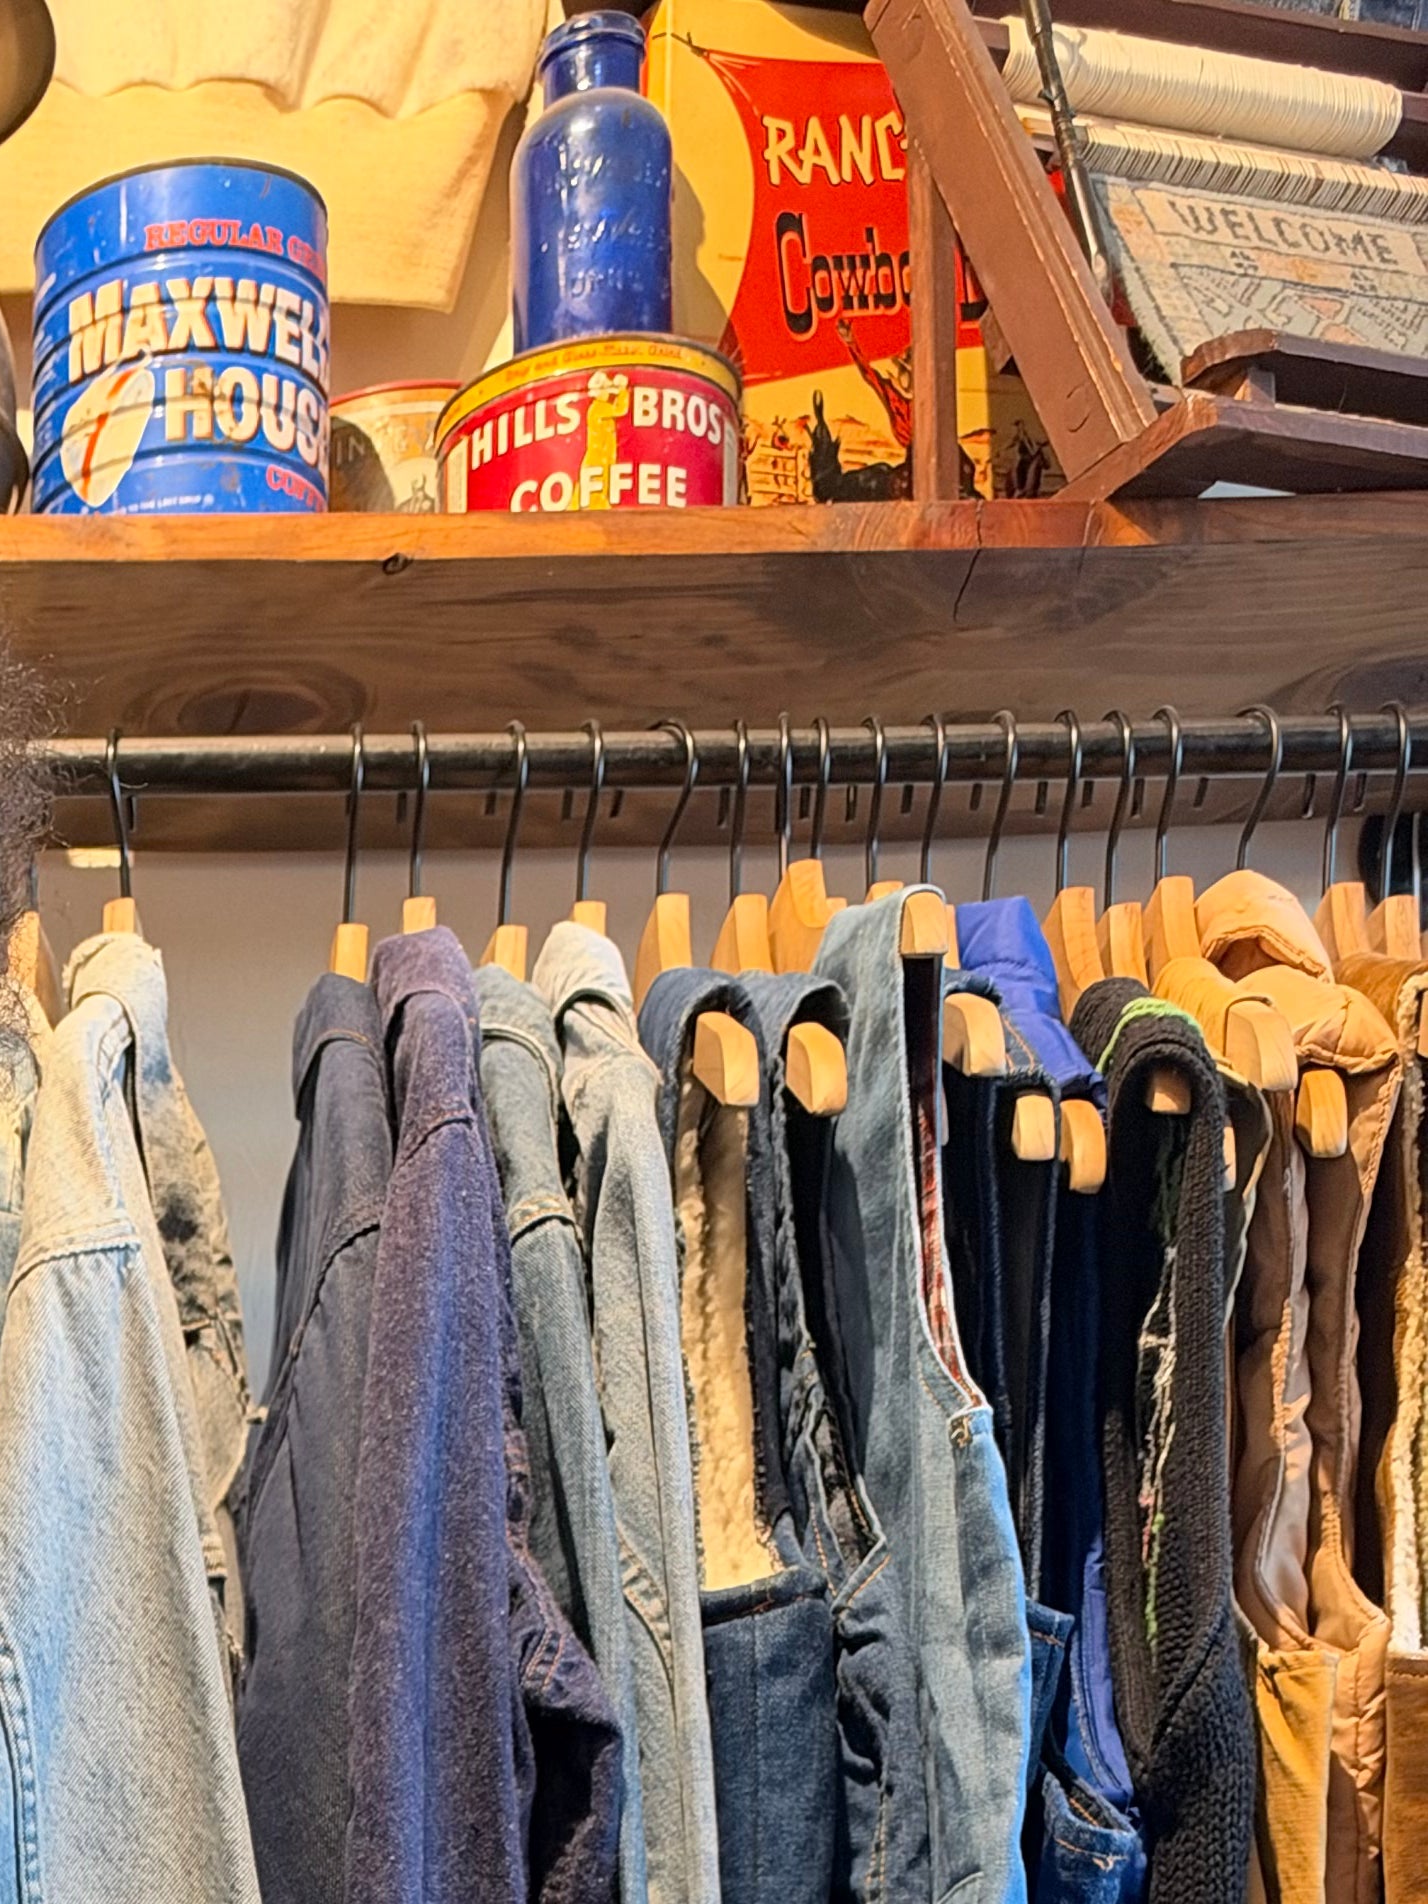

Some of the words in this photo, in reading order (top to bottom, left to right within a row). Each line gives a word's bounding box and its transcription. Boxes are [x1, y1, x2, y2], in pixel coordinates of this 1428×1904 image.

[762, 111, 908, 186] RANC
[144, 218, 284, 256] REGULAR
[1168, 199, 1399, 266] WELCOME
[471, 391, 581, 471] HILLS
[633, 385, 722, 445] BROS
[509, 462, 688, 513] COFFEE
